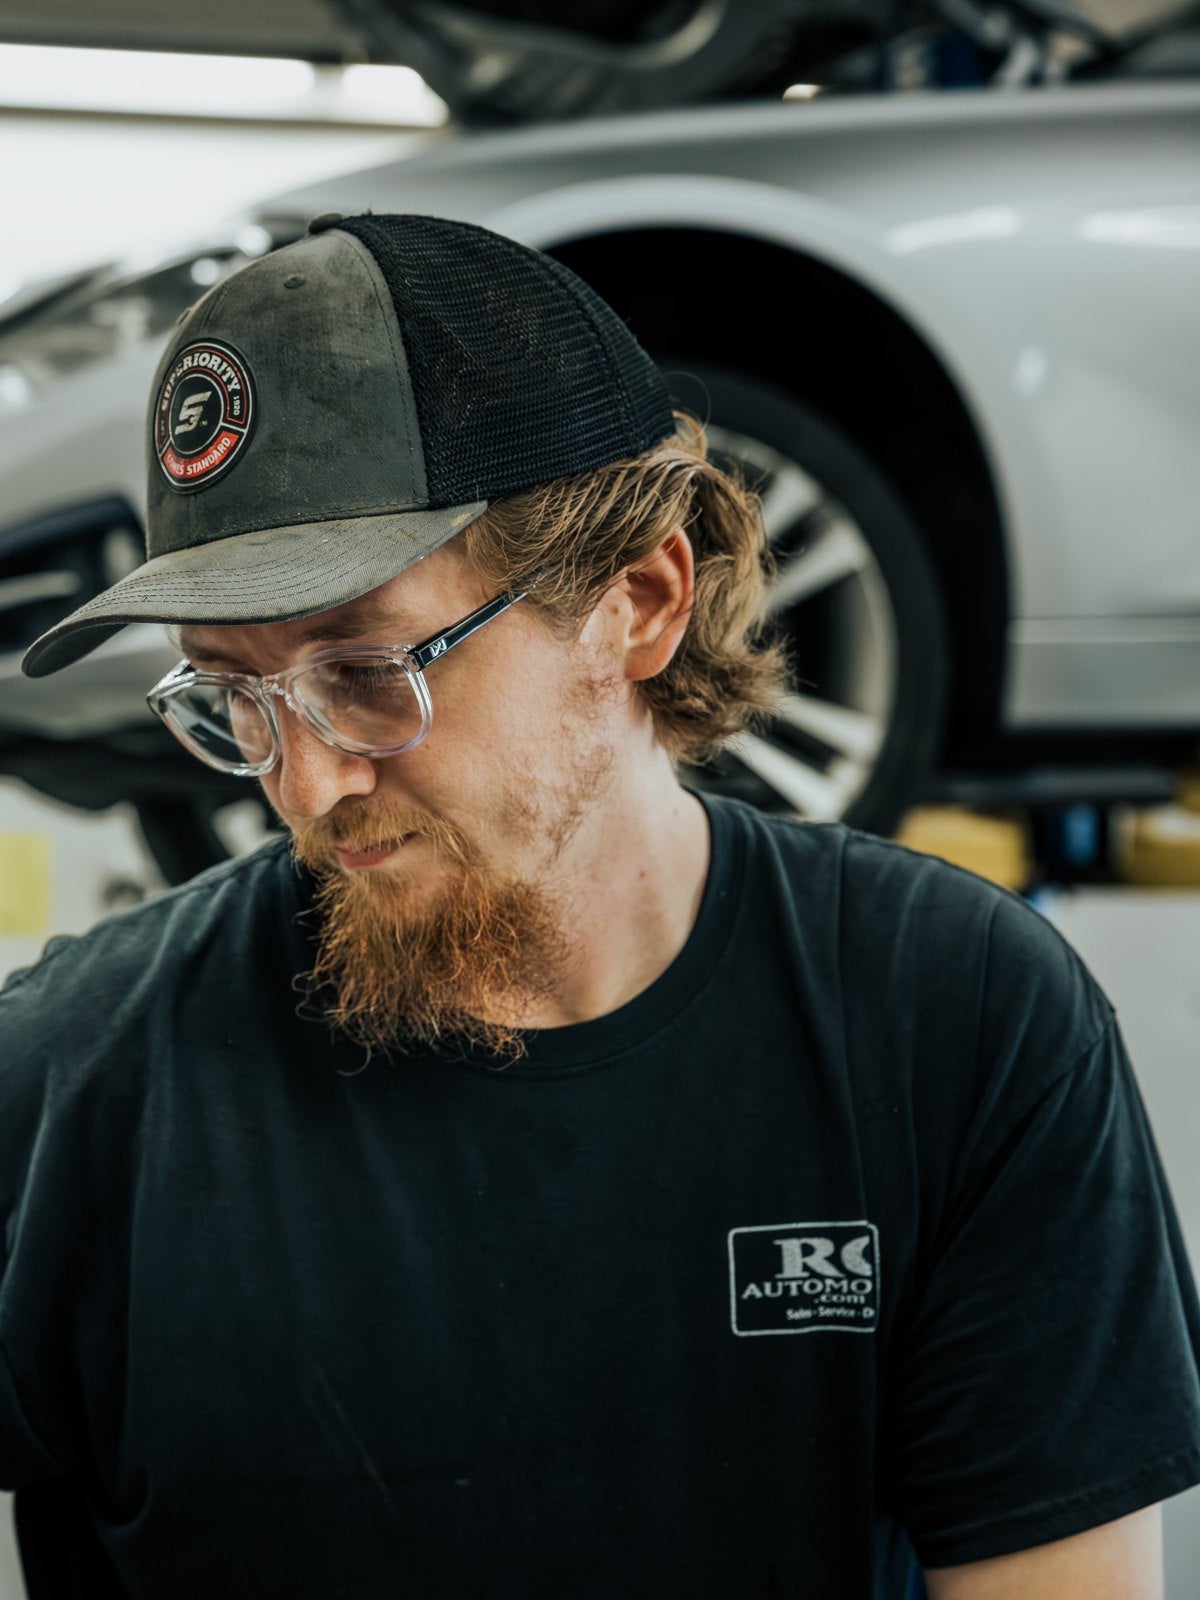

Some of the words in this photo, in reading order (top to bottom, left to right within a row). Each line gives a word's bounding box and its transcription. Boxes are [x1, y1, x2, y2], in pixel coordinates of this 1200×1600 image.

[186, 437, 231, 475] STANDARD
[741, 1278, 873, 1299] AUTOMO
[814, 1293, 865, 1304] .com
